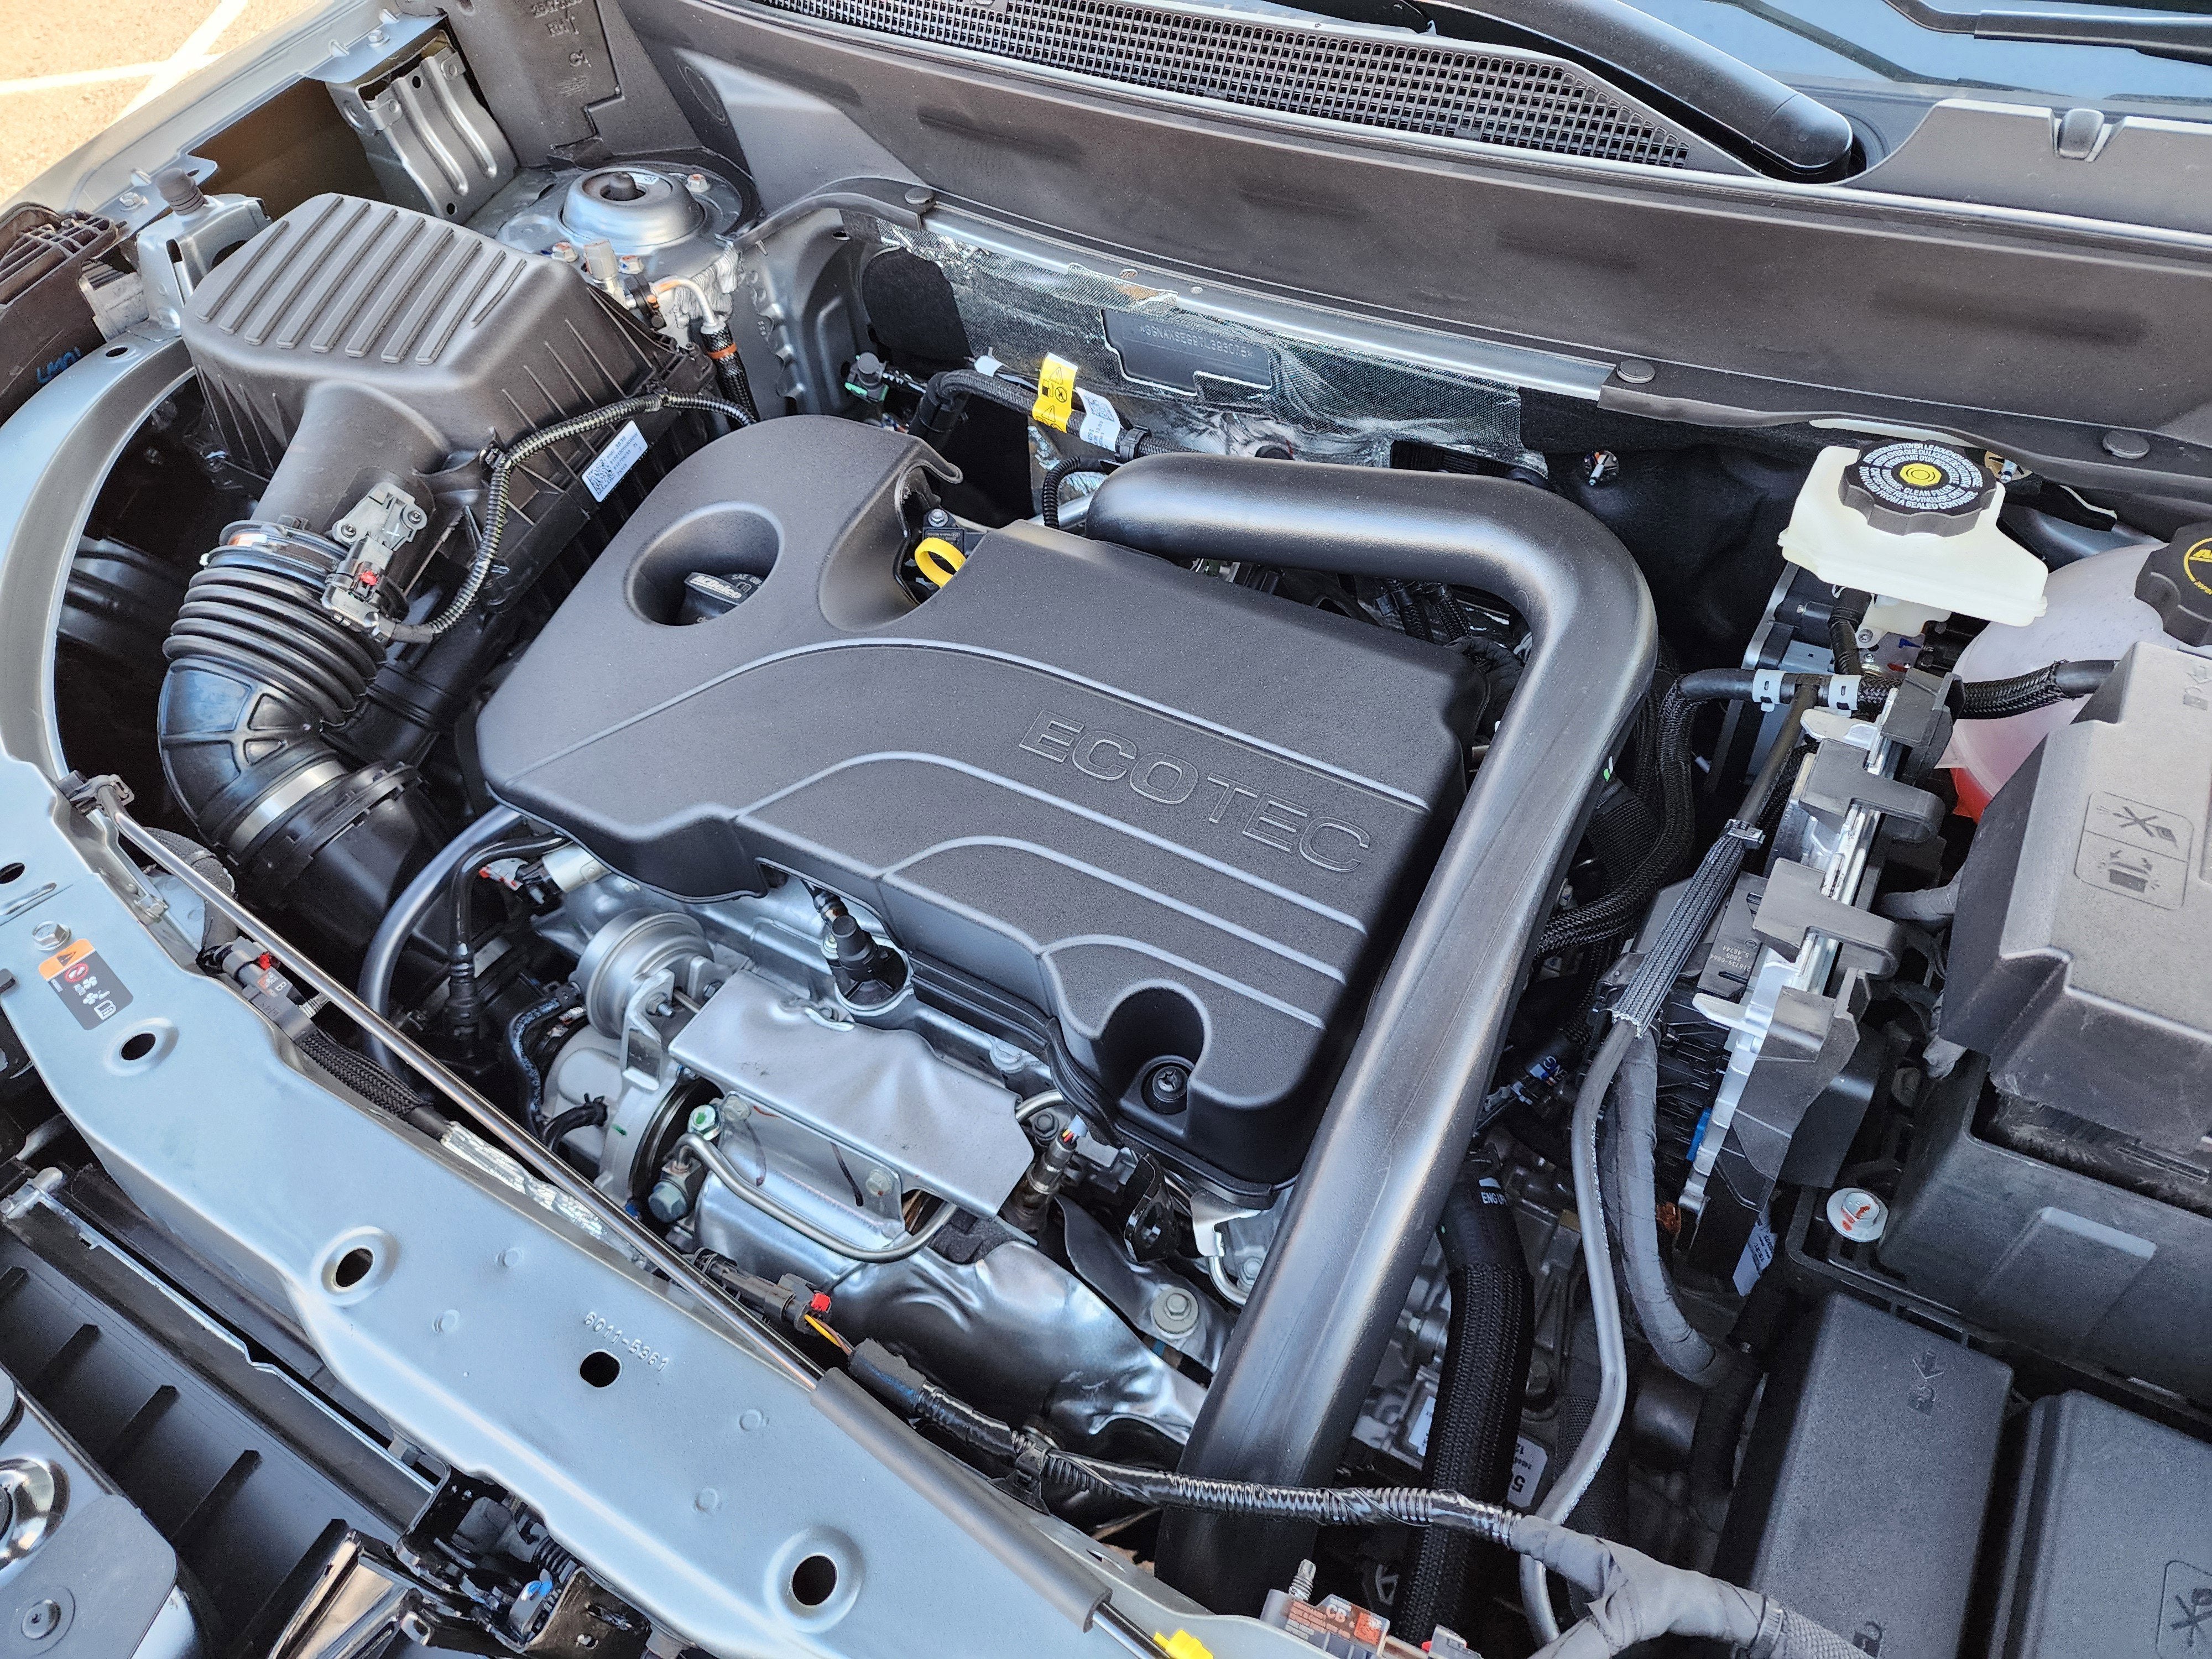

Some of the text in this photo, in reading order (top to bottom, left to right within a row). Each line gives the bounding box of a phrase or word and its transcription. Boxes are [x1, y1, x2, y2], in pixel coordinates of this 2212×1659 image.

[1870, 468, 1881, 477] CAP
[1862, 478, 1881, 493] FLUID
[1876, 490, 1900, 504] FROM
[1905, 500, 1939, 509] SEALED
[1872, 477, 1897, 494] BEFORE
[1903, 487, 1931, 497] CLEAN
[1931, 484, 1956, 497] FILLER
[1947, 487, 1966, 499] ONLY
[691, 575, 742, 599] ACDelco
[1019, 710, 1371, 872] ECOTEC
[1480, 1192, 1498, 1204] ENG
[583, 1311, 670, 1373] 6011-5361
